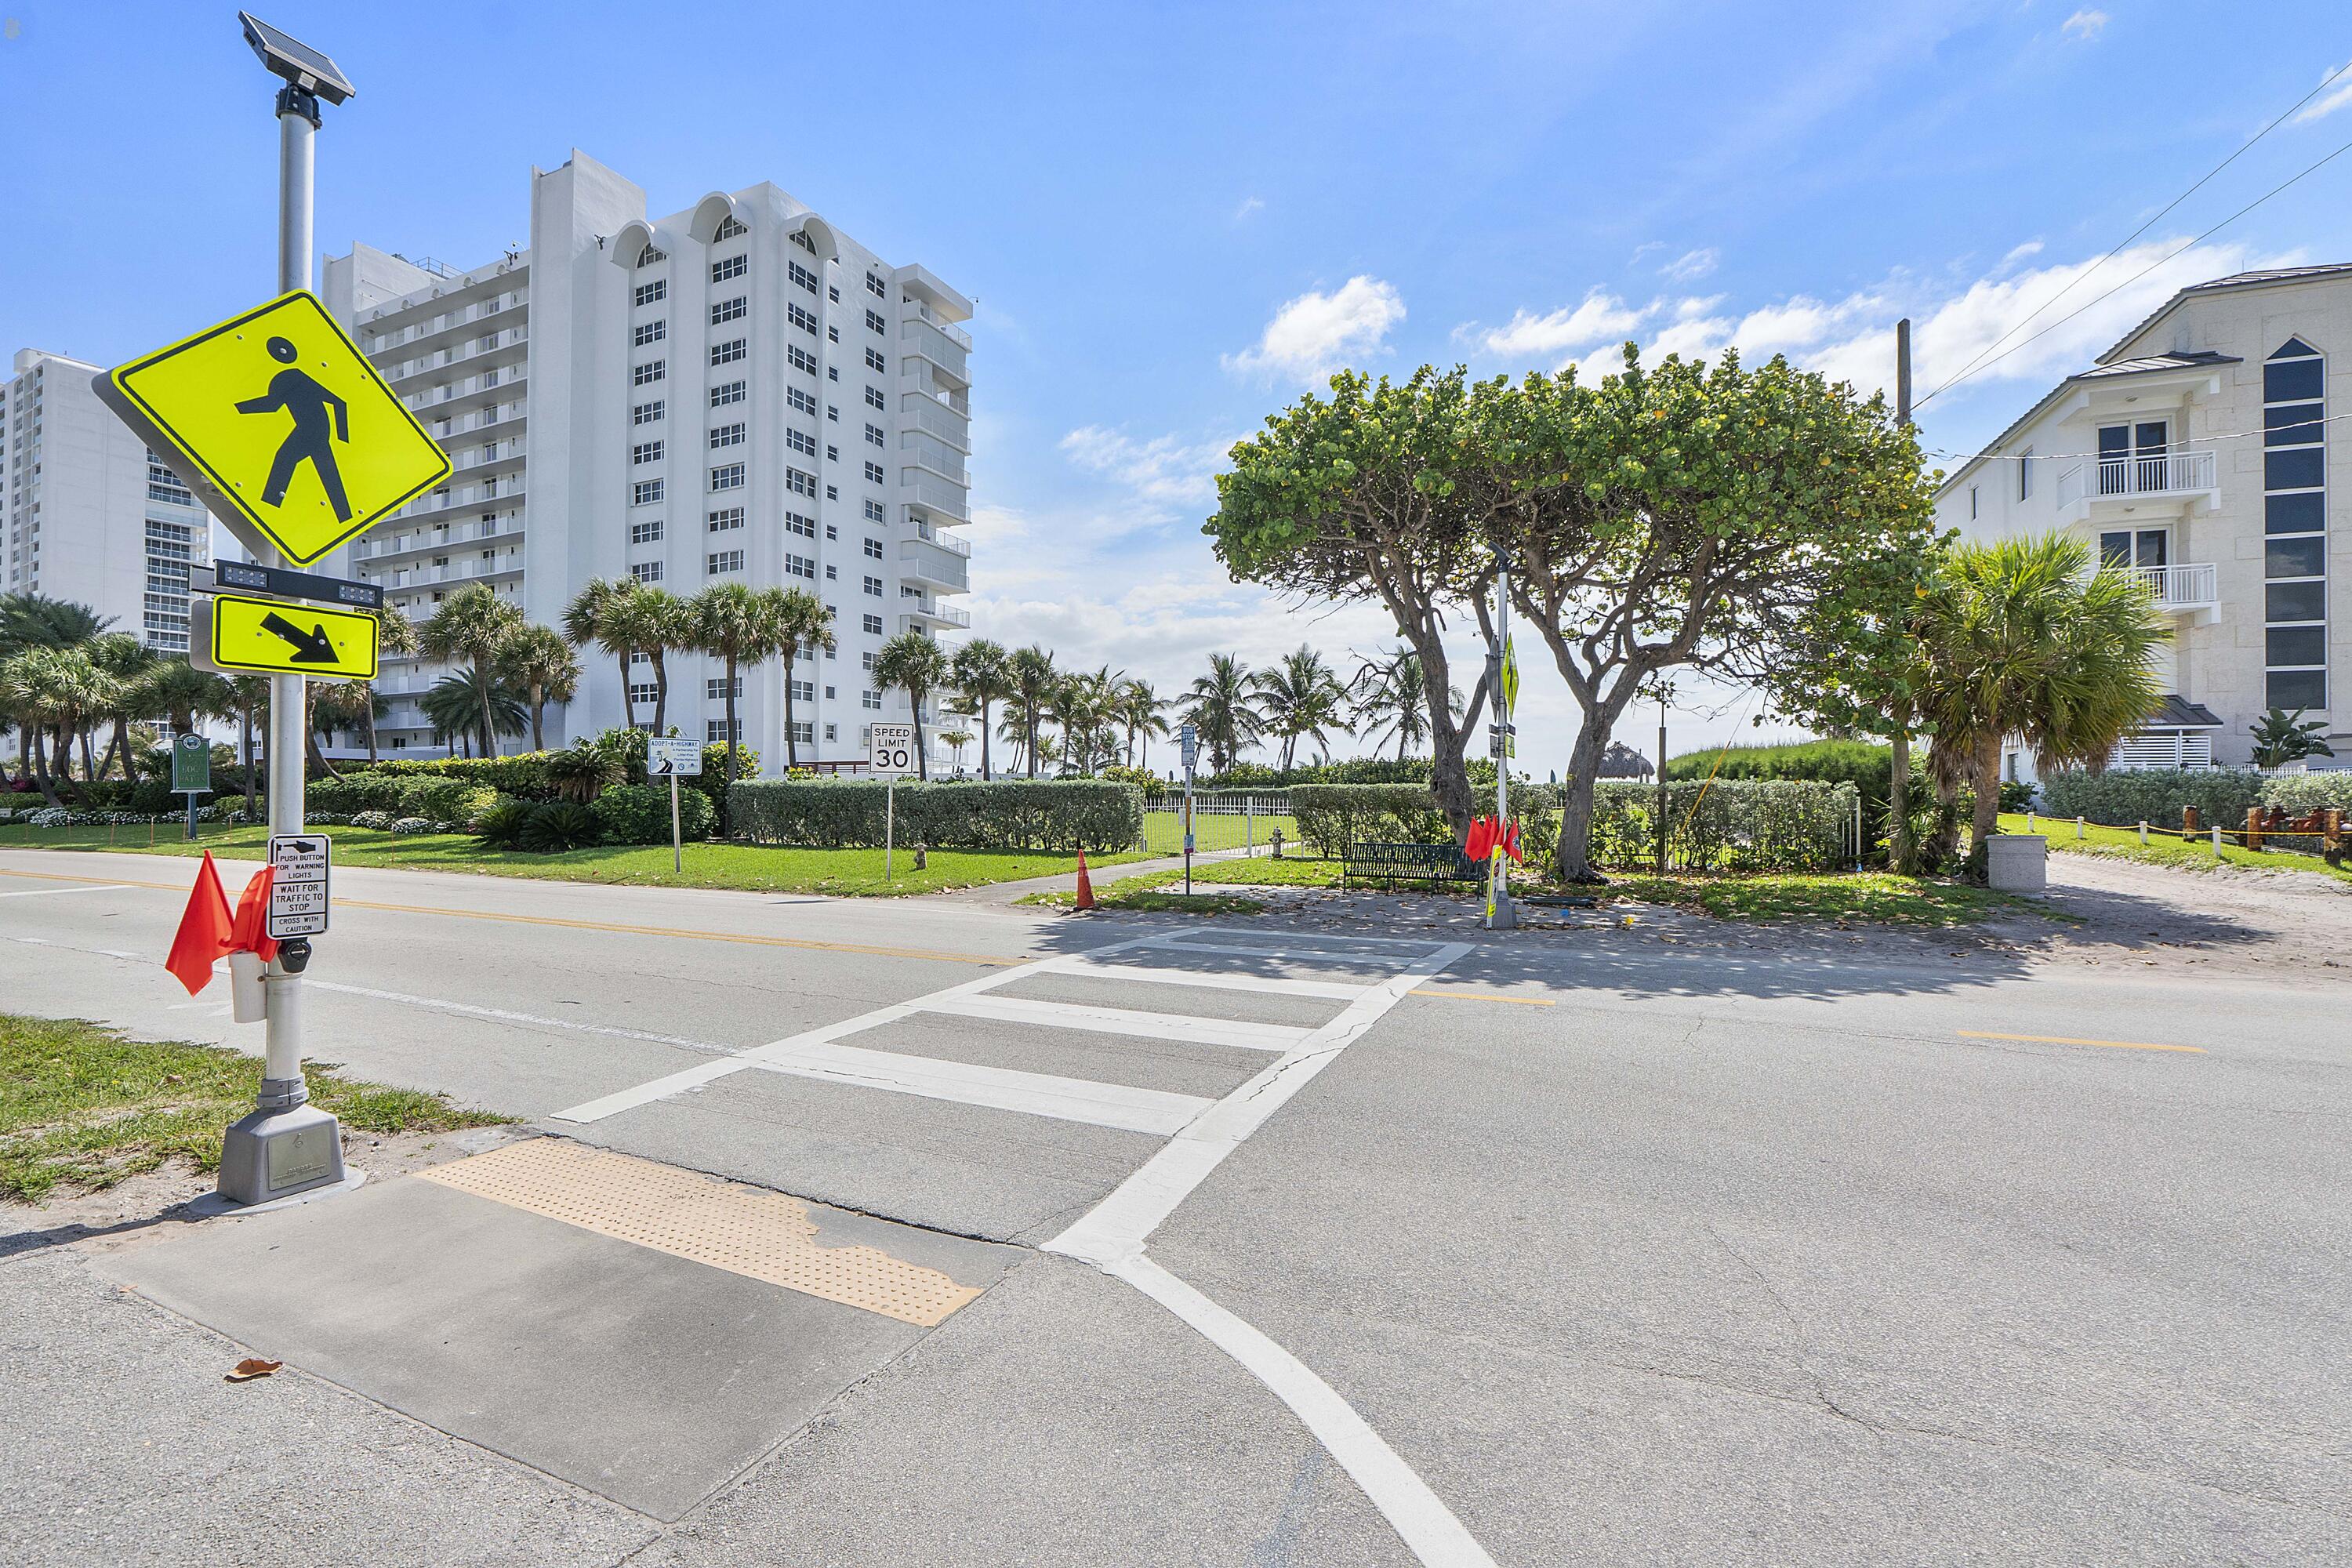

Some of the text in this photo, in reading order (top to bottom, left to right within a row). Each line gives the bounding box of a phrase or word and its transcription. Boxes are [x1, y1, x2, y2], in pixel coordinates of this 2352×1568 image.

[874, 728, 909, 737] SPEED
[878, 739, 906, 747] LIMIT
[876, 750, 908, 768] 30
[276, 894, 310, 902] TRAFFIC
[289, 903, 310, 912] STOP
